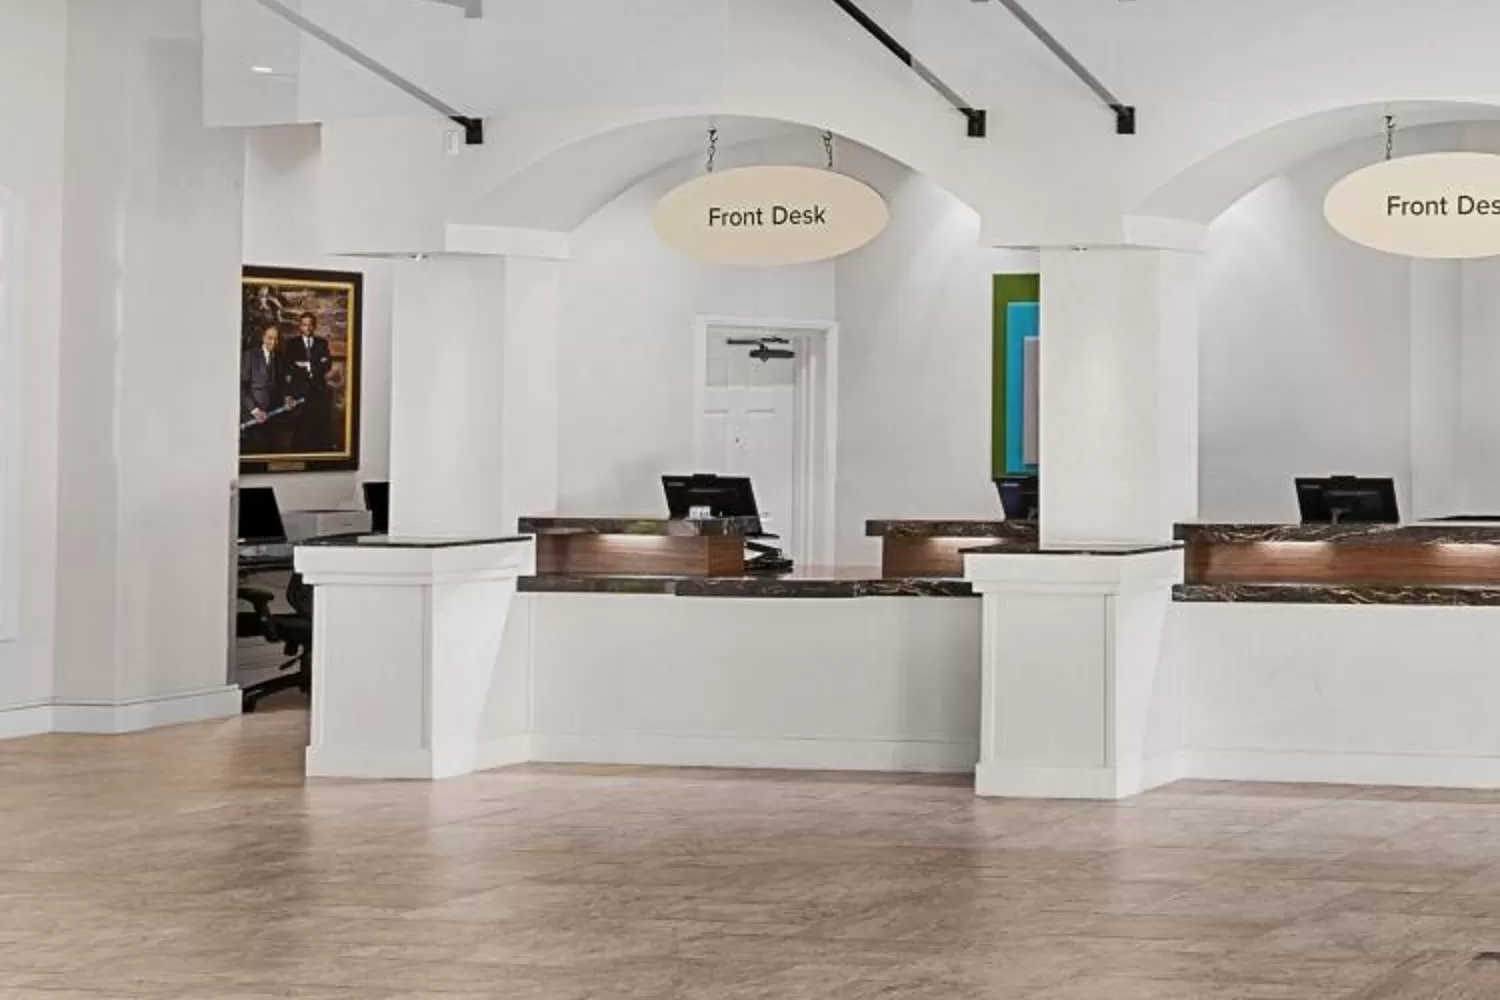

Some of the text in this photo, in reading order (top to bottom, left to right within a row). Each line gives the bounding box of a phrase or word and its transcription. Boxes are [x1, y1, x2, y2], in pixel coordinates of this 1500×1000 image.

[708, 204, 827, 227] Front Desk
[1386, 195, 1448, 217] Front
